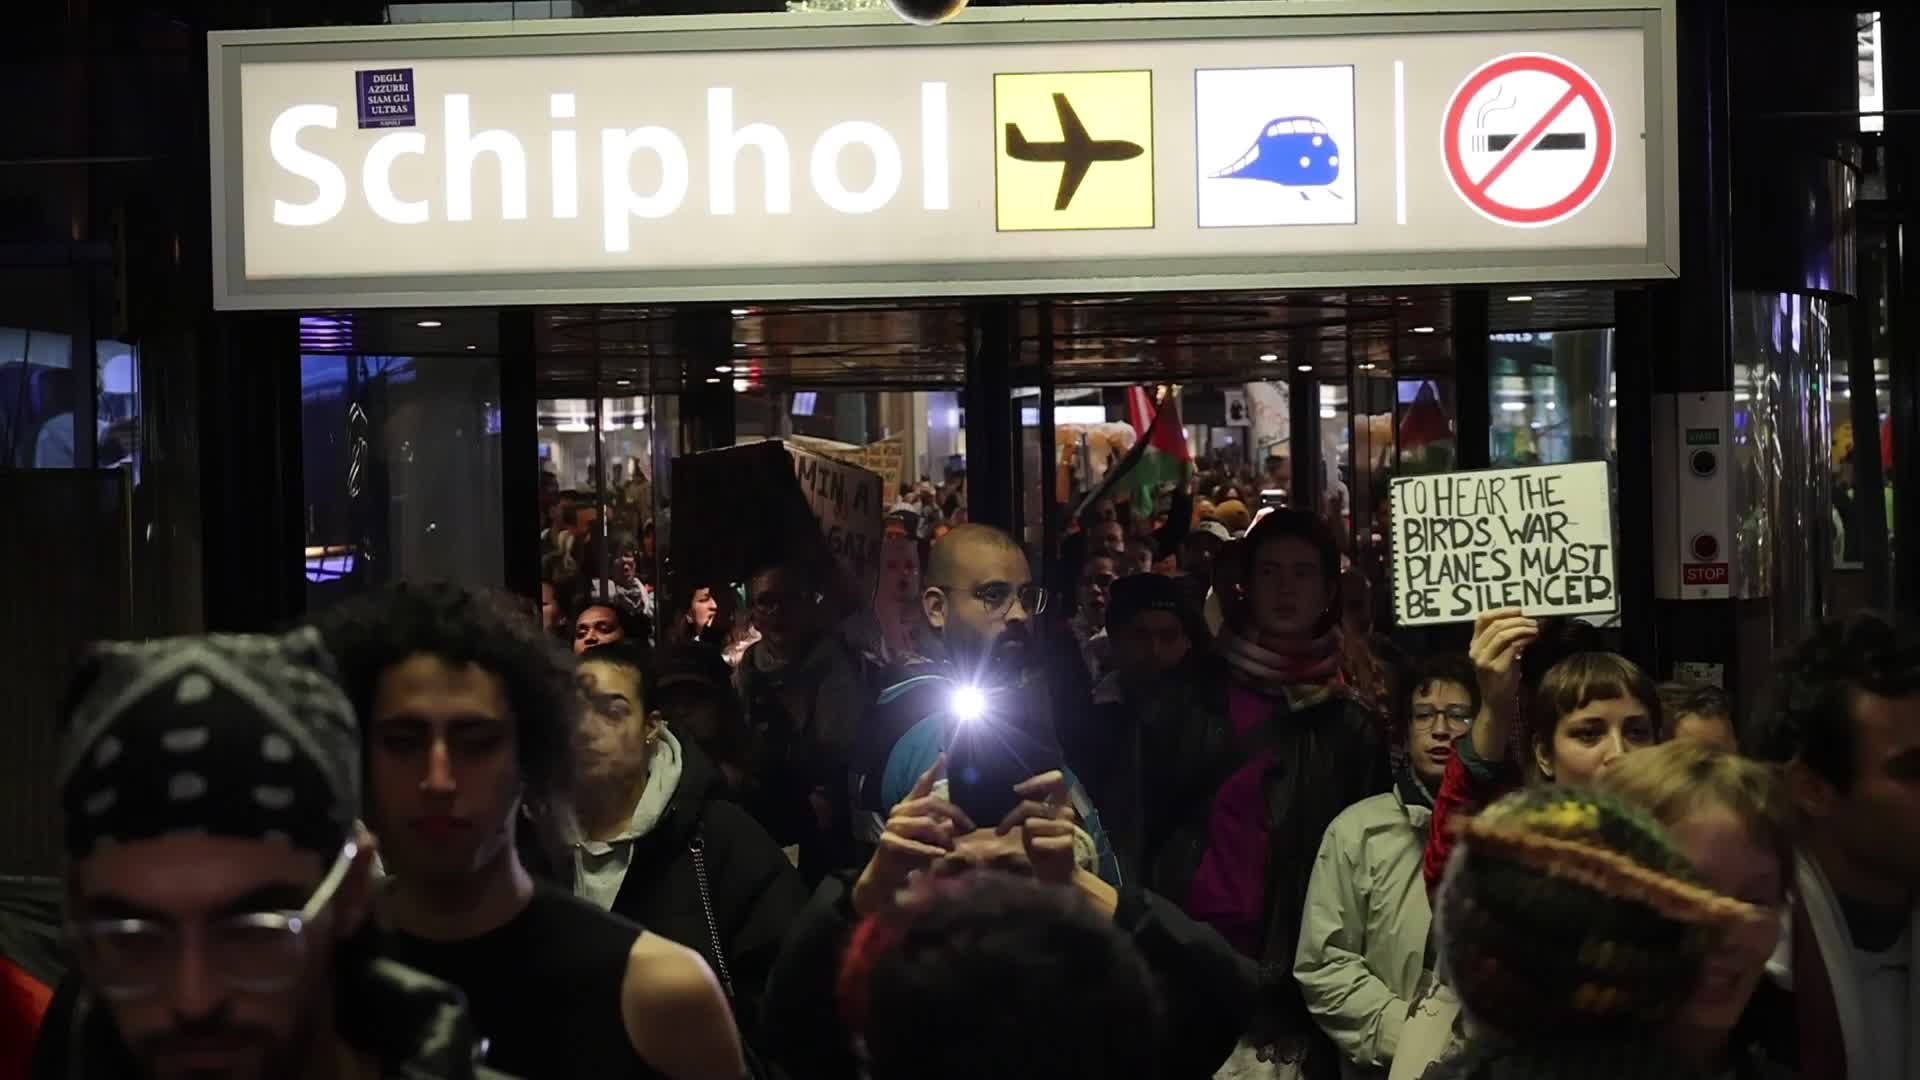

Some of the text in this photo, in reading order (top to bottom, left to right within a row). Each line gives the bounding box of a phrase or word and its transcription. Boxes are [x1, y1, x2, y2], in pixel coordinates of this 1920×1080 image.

[373, 73, 402, 83] DEGLI
[368, 83, 408, 94] AZZURRI
[368, 94, 410, 104] SIAM GLI
[371, 105, 408, 114] ULTRAS
[269, 81, 949, 252] Schiphol
[1393, 475, 1564, 516] TO HEAR THE
[1405, 544, 1608, 589] PLANES MUST
[1687, 567, 1725, 582] STOP
[1405, 588, 1440, 619] BE
